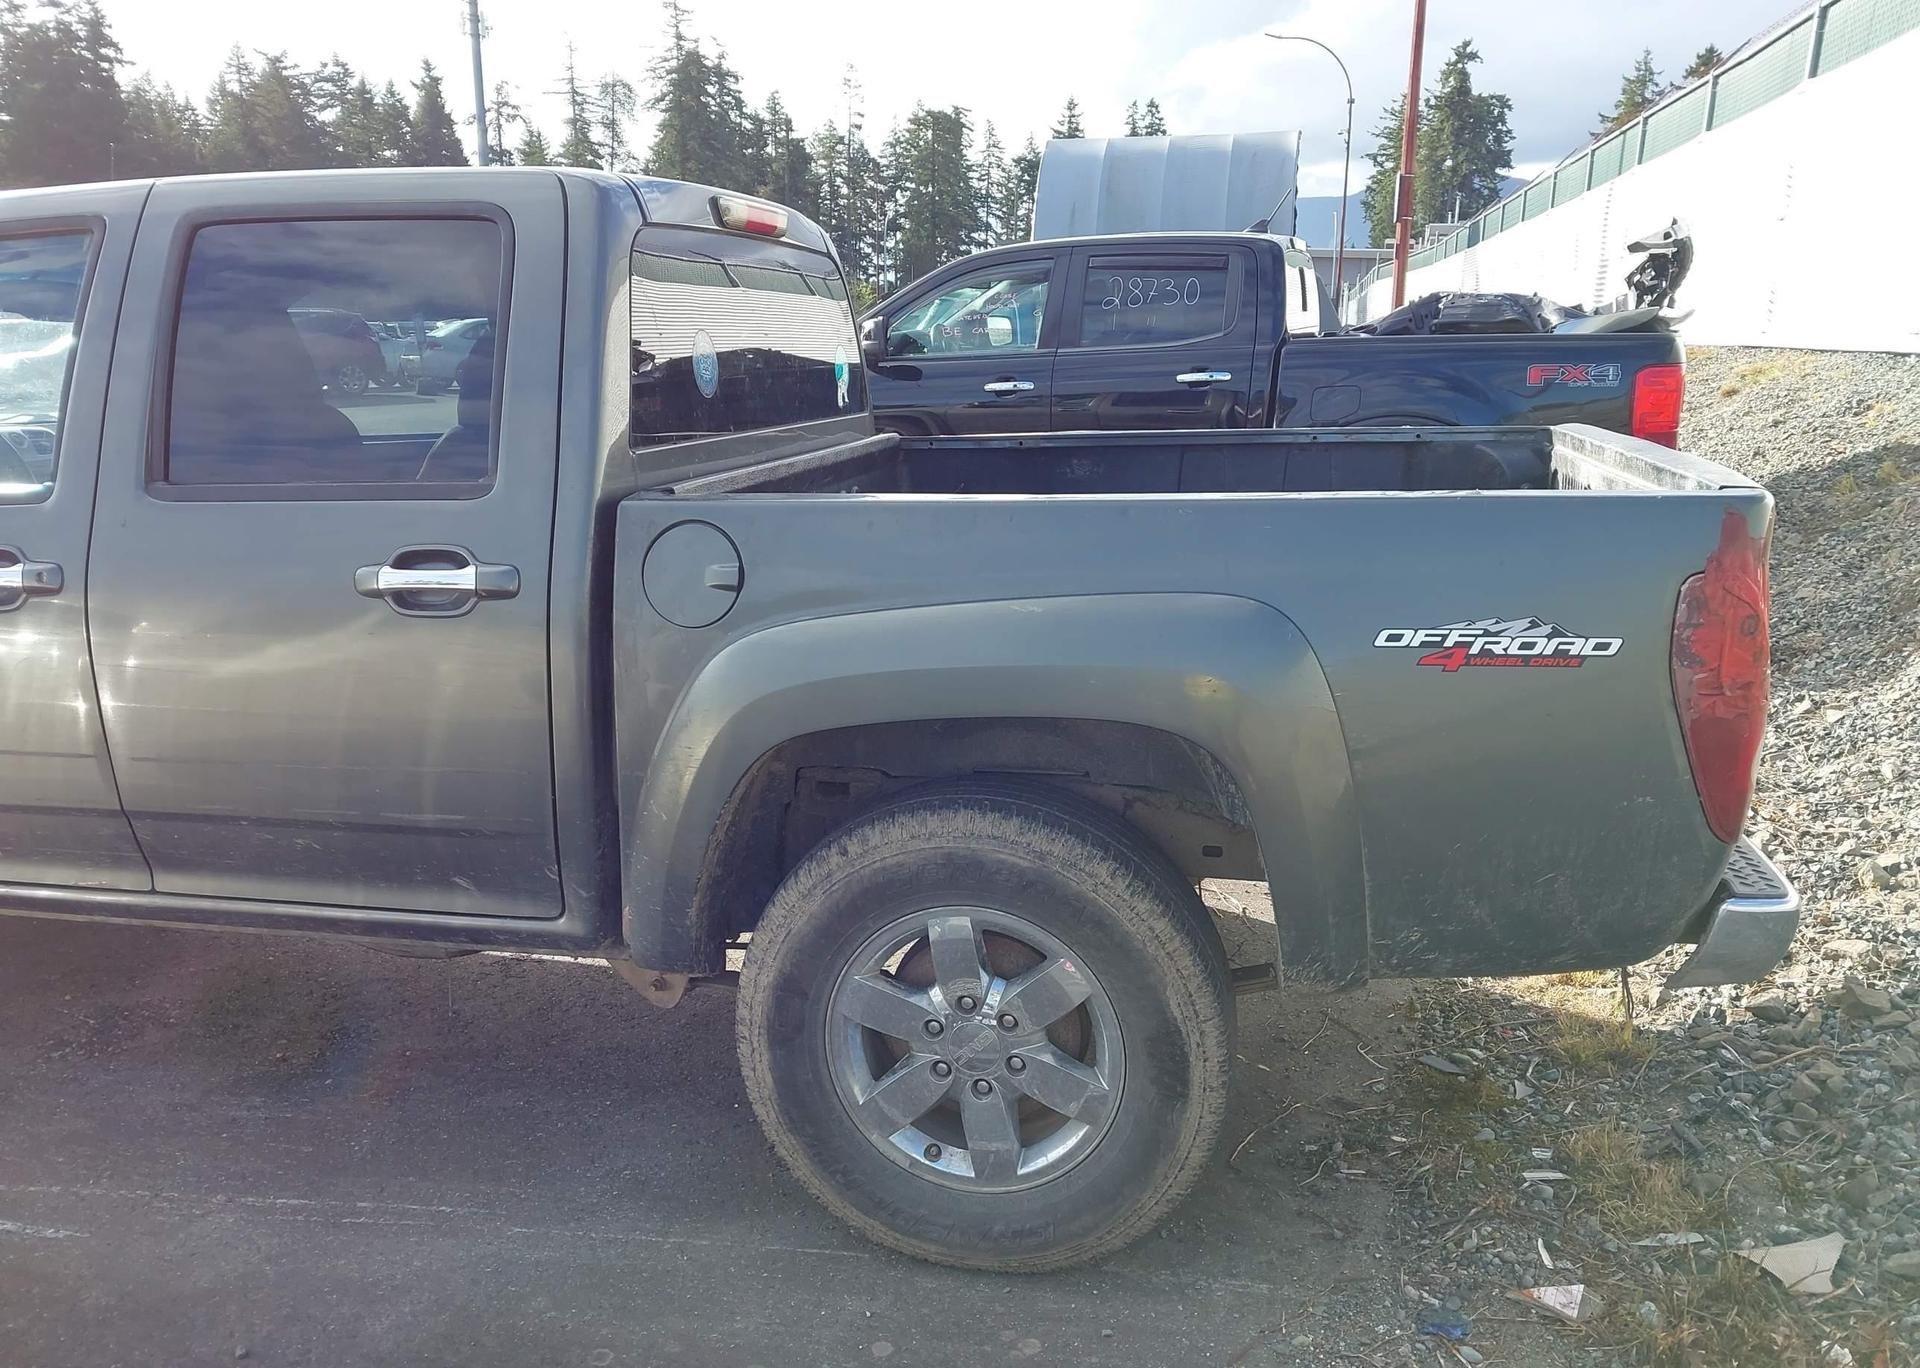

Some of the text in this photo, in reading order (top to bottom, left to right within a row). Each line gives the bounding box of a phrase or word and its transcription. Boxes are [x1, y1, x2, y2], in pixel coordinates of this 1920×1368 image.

[1102, 276, 1201, 310] 28730
[942, 326, 962, 337] BE
[1526, 363, 1621, 386] FX4
[1416, 646, 1583, 672] 4 WHEEL DRIVE
